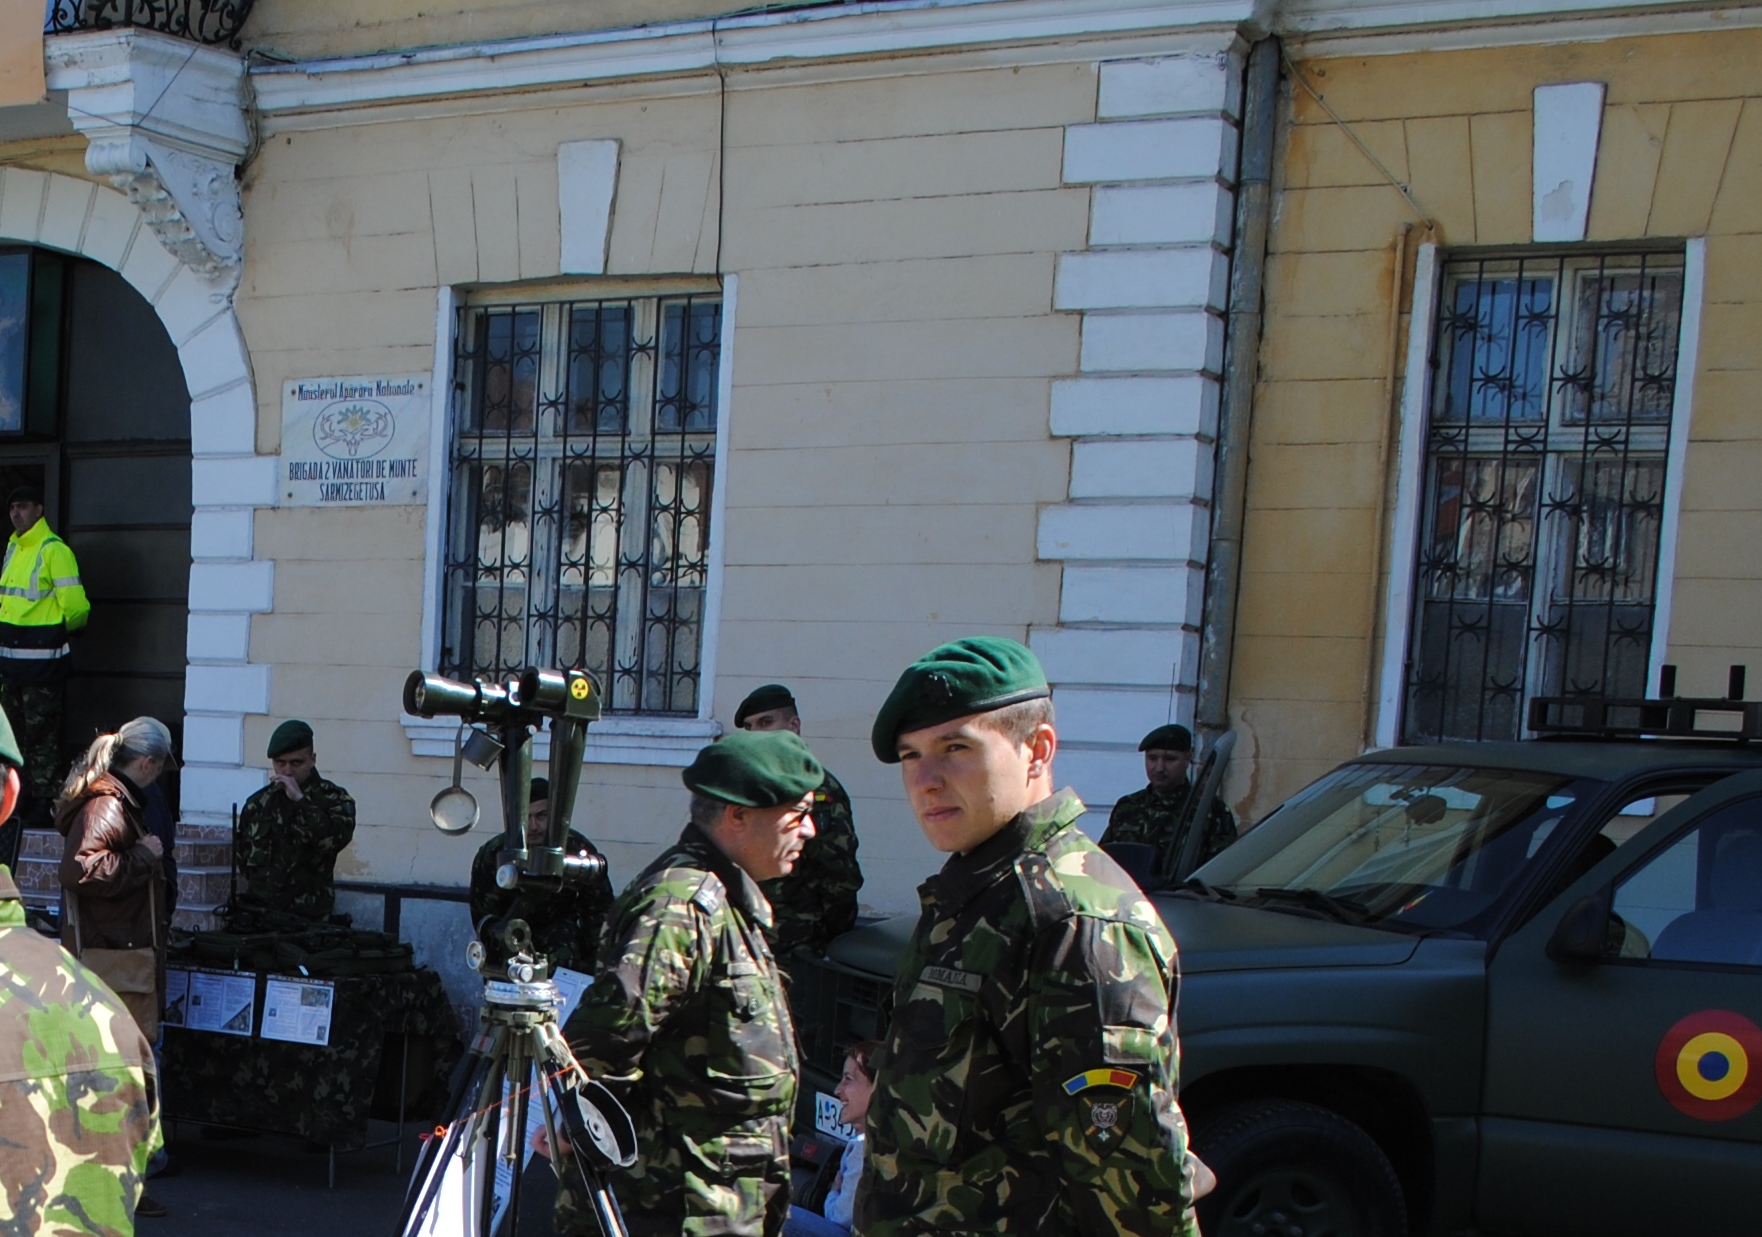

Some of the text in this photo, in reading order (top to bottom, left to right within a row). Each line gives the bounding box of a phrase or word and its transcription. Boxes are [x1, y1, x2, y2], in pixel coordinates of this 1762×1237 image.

[298, 382, 338, 401] Ministerul
[289, 461, 323, 481] BRIGADA
[325, 460, 331, 480] 2
[376, 460, 387, 478] DE
[388, 458, 418, 478] MUNTE
[319, 481, 385, 501] SARMIZEGETUSA
